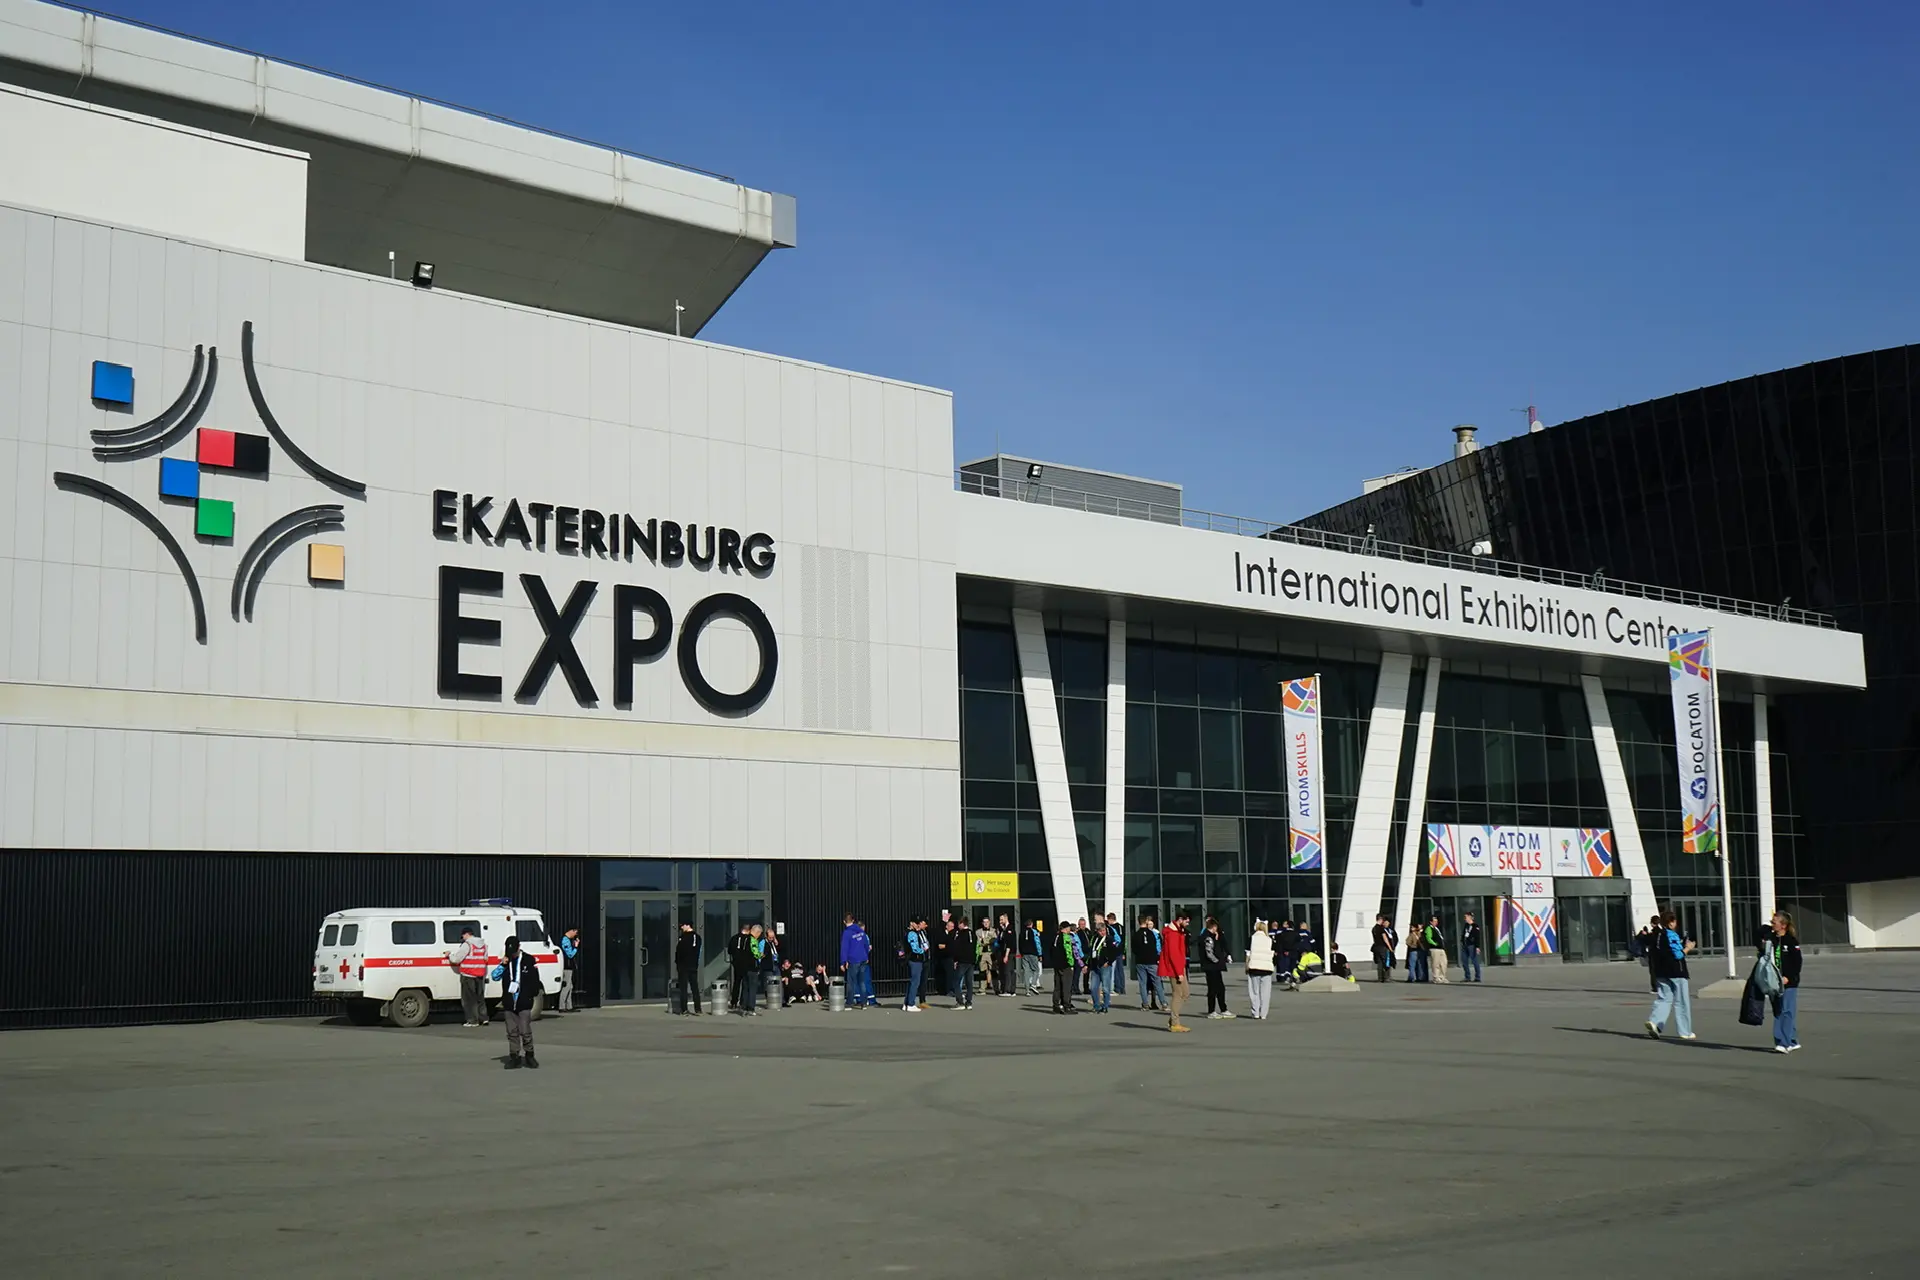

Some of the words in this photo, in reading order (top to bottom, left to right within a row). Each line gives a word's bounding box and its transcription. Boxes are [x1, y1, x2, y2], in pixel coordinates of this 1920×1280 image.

[433, 489, 776, 579] EKATERINBURG
[437, 564, 778, 718] EXPO
[1235, 551, 1449, 621] International
[1460, 585, 1597, 640] Exhibition
[1605, 606, 1688, 649] Cent
[1295, 731, 1310, 817] ATOMSKILLS
[1687, 692, 1706, 774] РОСАТОМ
[1498, 832, 1541, 850] ATOM
[1498, 851, 1542, 870] SKILLS
